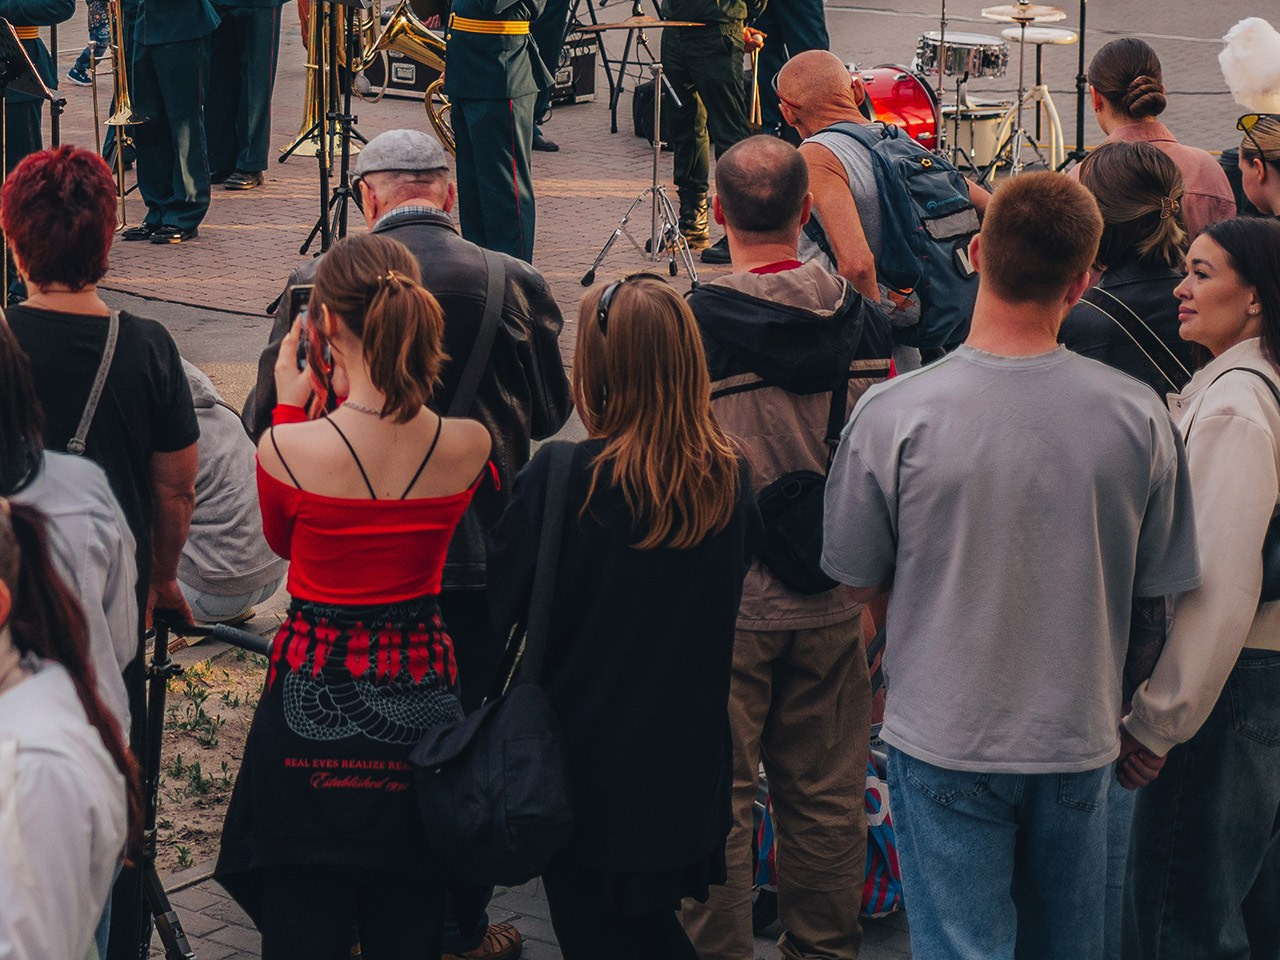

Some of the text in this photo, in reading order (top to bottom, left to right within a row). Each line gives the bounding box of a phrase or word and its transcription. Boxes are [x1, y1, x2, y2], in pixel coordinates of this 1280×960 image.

[285, 757, 310, 768] REAL
[312, 758, 339, 769] EYES
[341, 759, 385, 770] REALIZE
